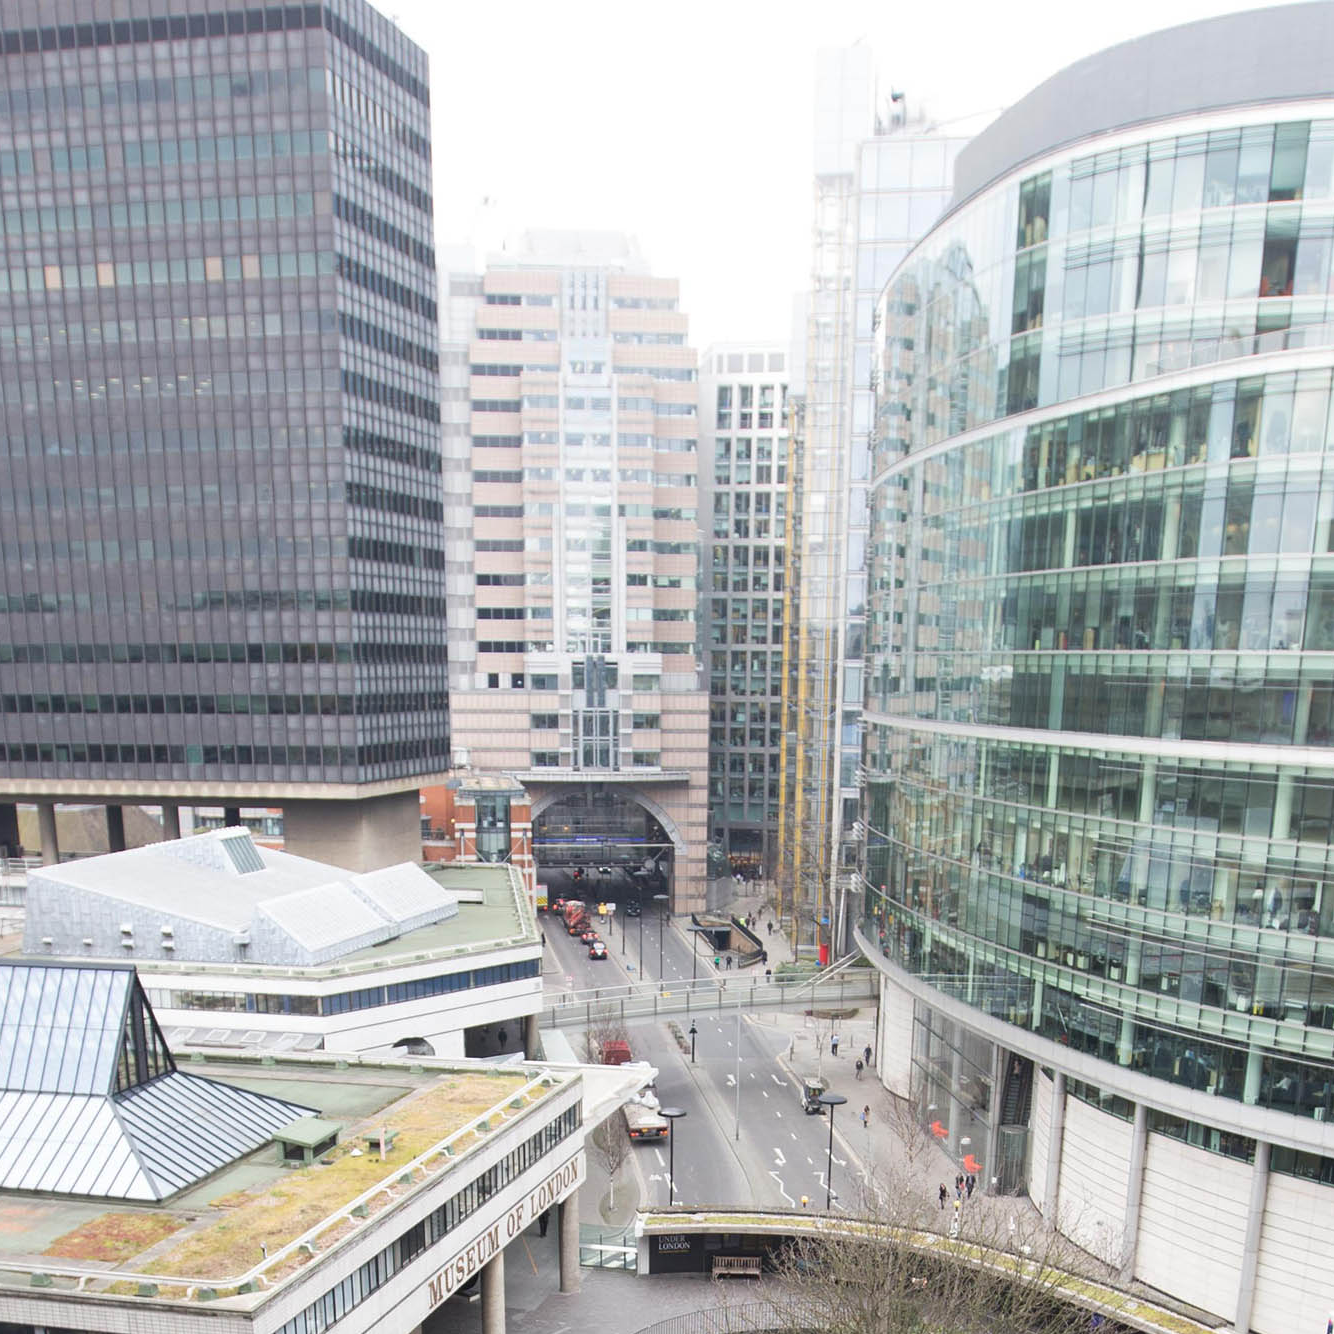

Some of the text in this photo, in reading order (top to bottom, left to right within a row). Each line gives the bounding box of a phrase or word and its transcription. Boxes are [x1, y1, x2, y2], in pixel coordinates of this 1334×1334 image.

[428, 1157, 579, 1310] MUSEUM OF LONDON
[658, 1241, 691, 1250] LONDON
